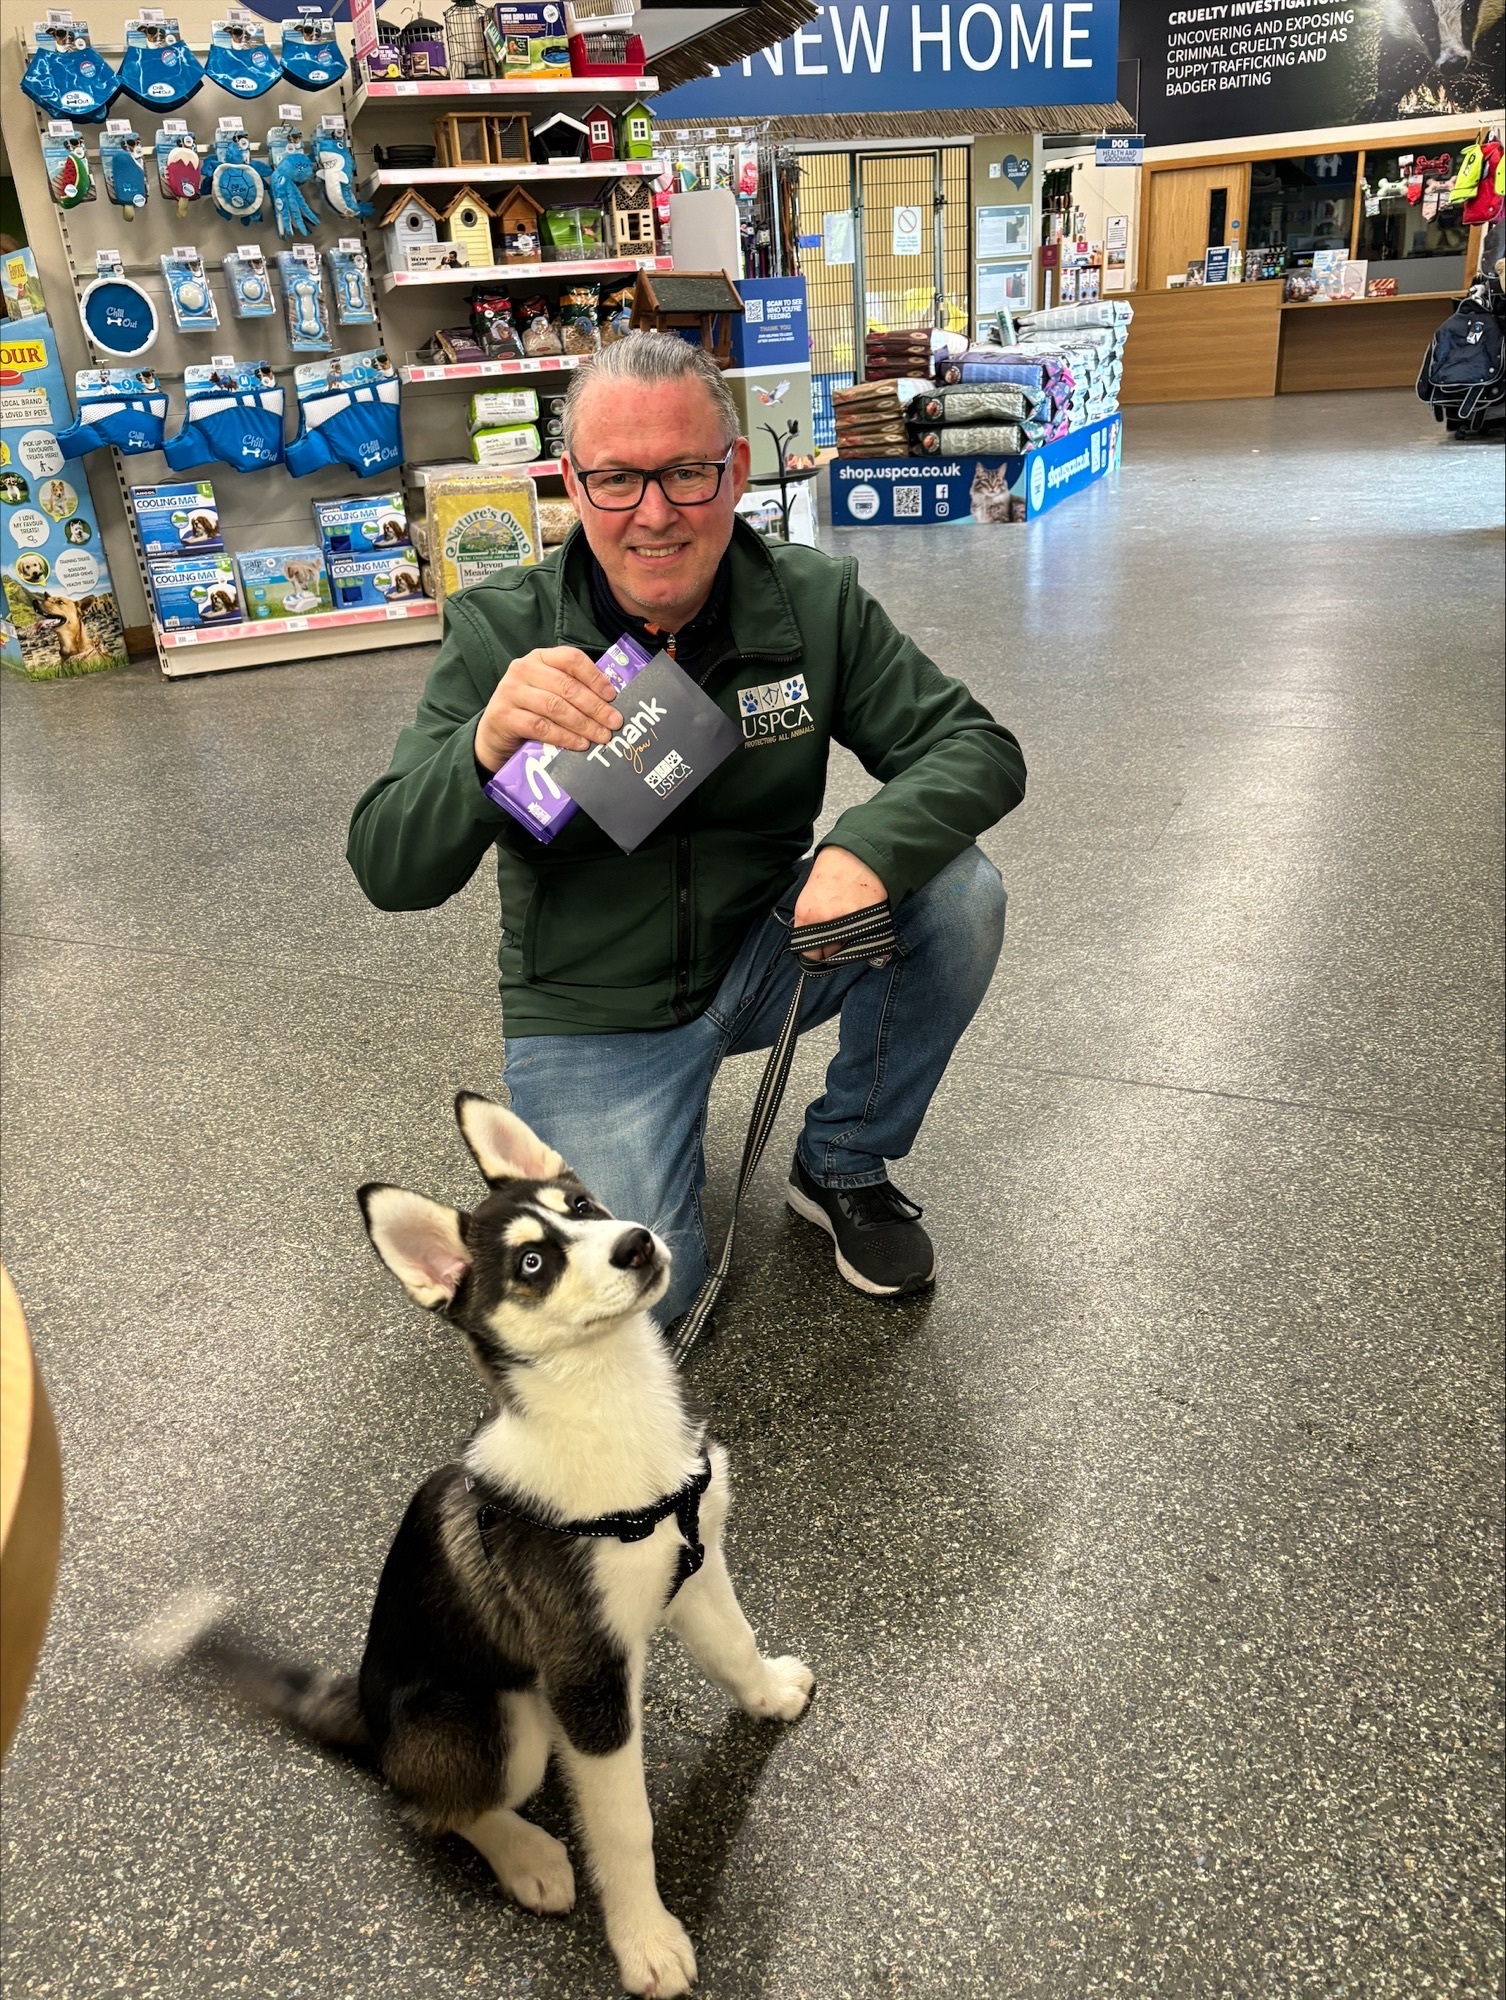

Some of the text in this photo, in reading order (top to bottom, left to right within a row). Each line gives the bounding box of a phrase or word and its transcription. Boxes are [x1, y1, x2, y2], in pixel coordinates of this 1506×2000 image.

[1168, 5, 1228, 26] CRUELTY
[1168, 9, 1354, 47] UNCOVERING AND EXPOSING
[911, 2, 1094, 72] HOME
[1167, 28, 1348, 64] CRIMINAL CRUELTY SUCH AS
[1167, 48, 1327, 80] PUPPY TRAFFICKING AND
[1166, 71, 1272, 97] BADGER BAITING
[66, 92, 80, 100] Chill
[1112, 139, 1129, 148] DOG
[1102, 149, 1137, 157] HEALTH AND
[106, 306, 125, 318] Chill
[122, 319, 138, 329] Out
[2, 398, 42, 408] LOCAL BRAND
[5, 411, 24, 419] LOVED
[43, 438, 56, 446] YOUR
[128, 431, 145, 441] Chill
[242, 435, 265, 449] Chill
[28, 446, 54, 454] FAVOURITE
[358, 439, 381, 457] Chill
[381, 445, 399, 461] Out
[26, 453, 44, 461] TREATS
[260, 449, 278, 462] Out
[839, 463, 961, 482] shop.uspca.co.uk
[202, 484, 209, 494] L
[136, 495, 198, 509] COOLING MAT
[322, 508, 378, 523] COOLING MAT
[23, 520, 43, 528] FAVOUR
[446, 508, 528, 552] Nature's Own
[406, 550, 415, 558] M
[334, 560, 391, 574] COOLING MAT
[155, 571, 217, 584] COOLING MAT
[742, 704, 814, 739] USPCA
[587, 697, 667, 767] Thank
[744, 724, 815, 749] PROTECTING ALL ANIMALS
[654, 762, 692, 797] USPCA
